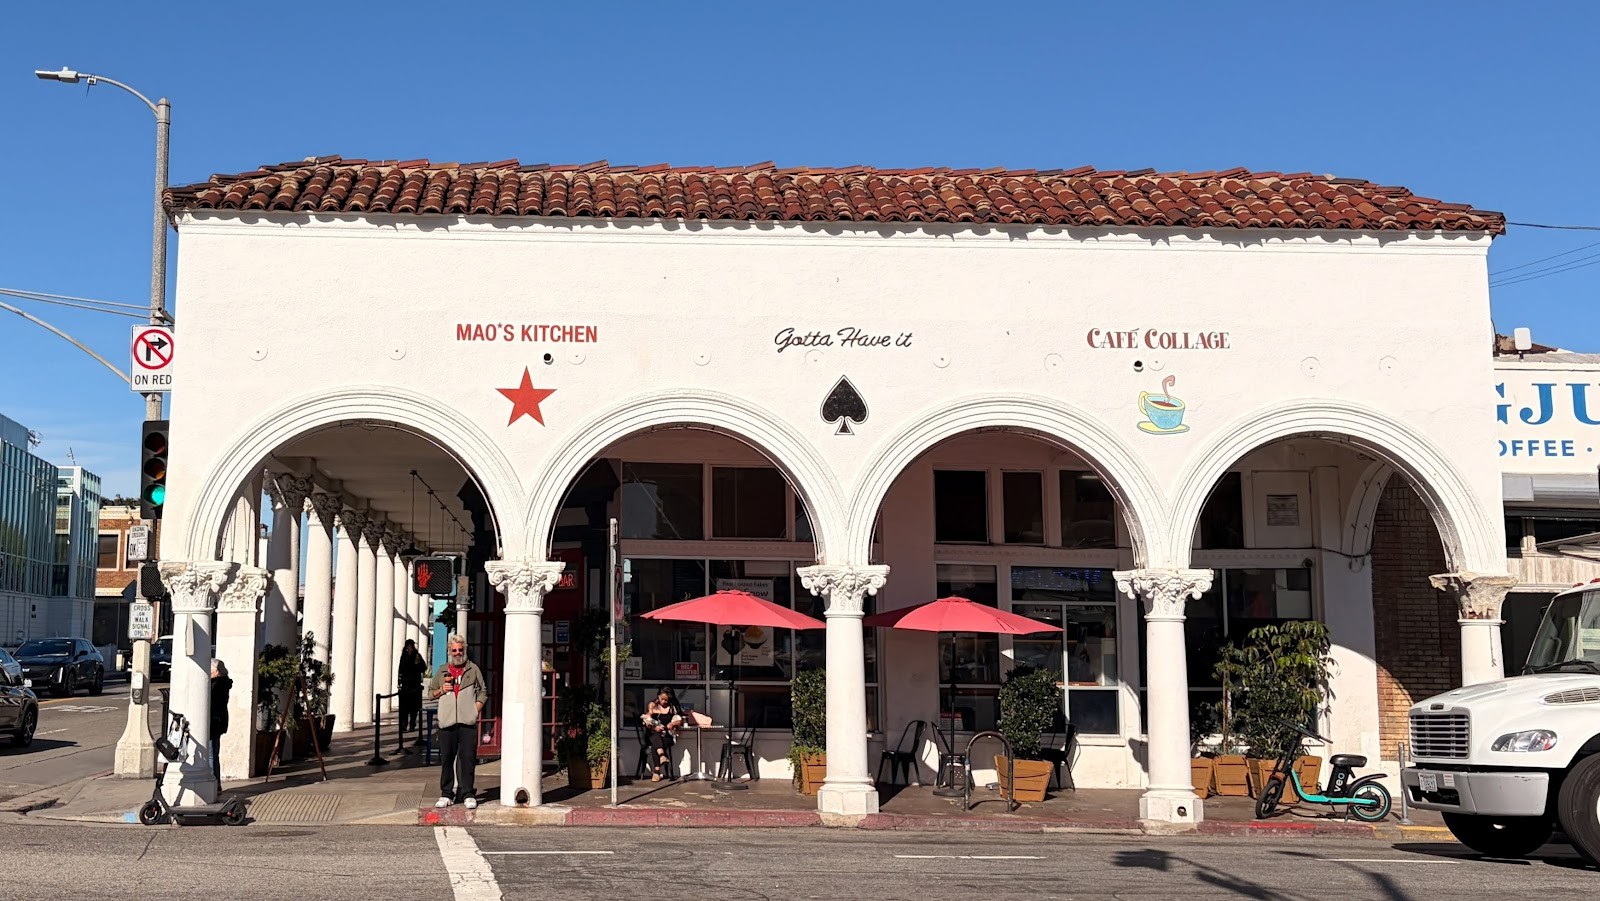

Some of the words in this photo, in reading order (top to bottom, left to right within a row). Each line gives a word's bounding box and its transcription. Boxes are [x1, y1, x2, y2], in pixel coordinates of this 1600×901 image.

[521, 324, 597, 343] KITCHEN
[774, 327, 834, 353] Gotta
[837, 327, 891, 348] Have
[895, 332, 913, 347] it
[1144, 328, 1231, 350] COLLAGE
[134, 374, 149, 385] ON
[152, 374, 172, 385] RED
